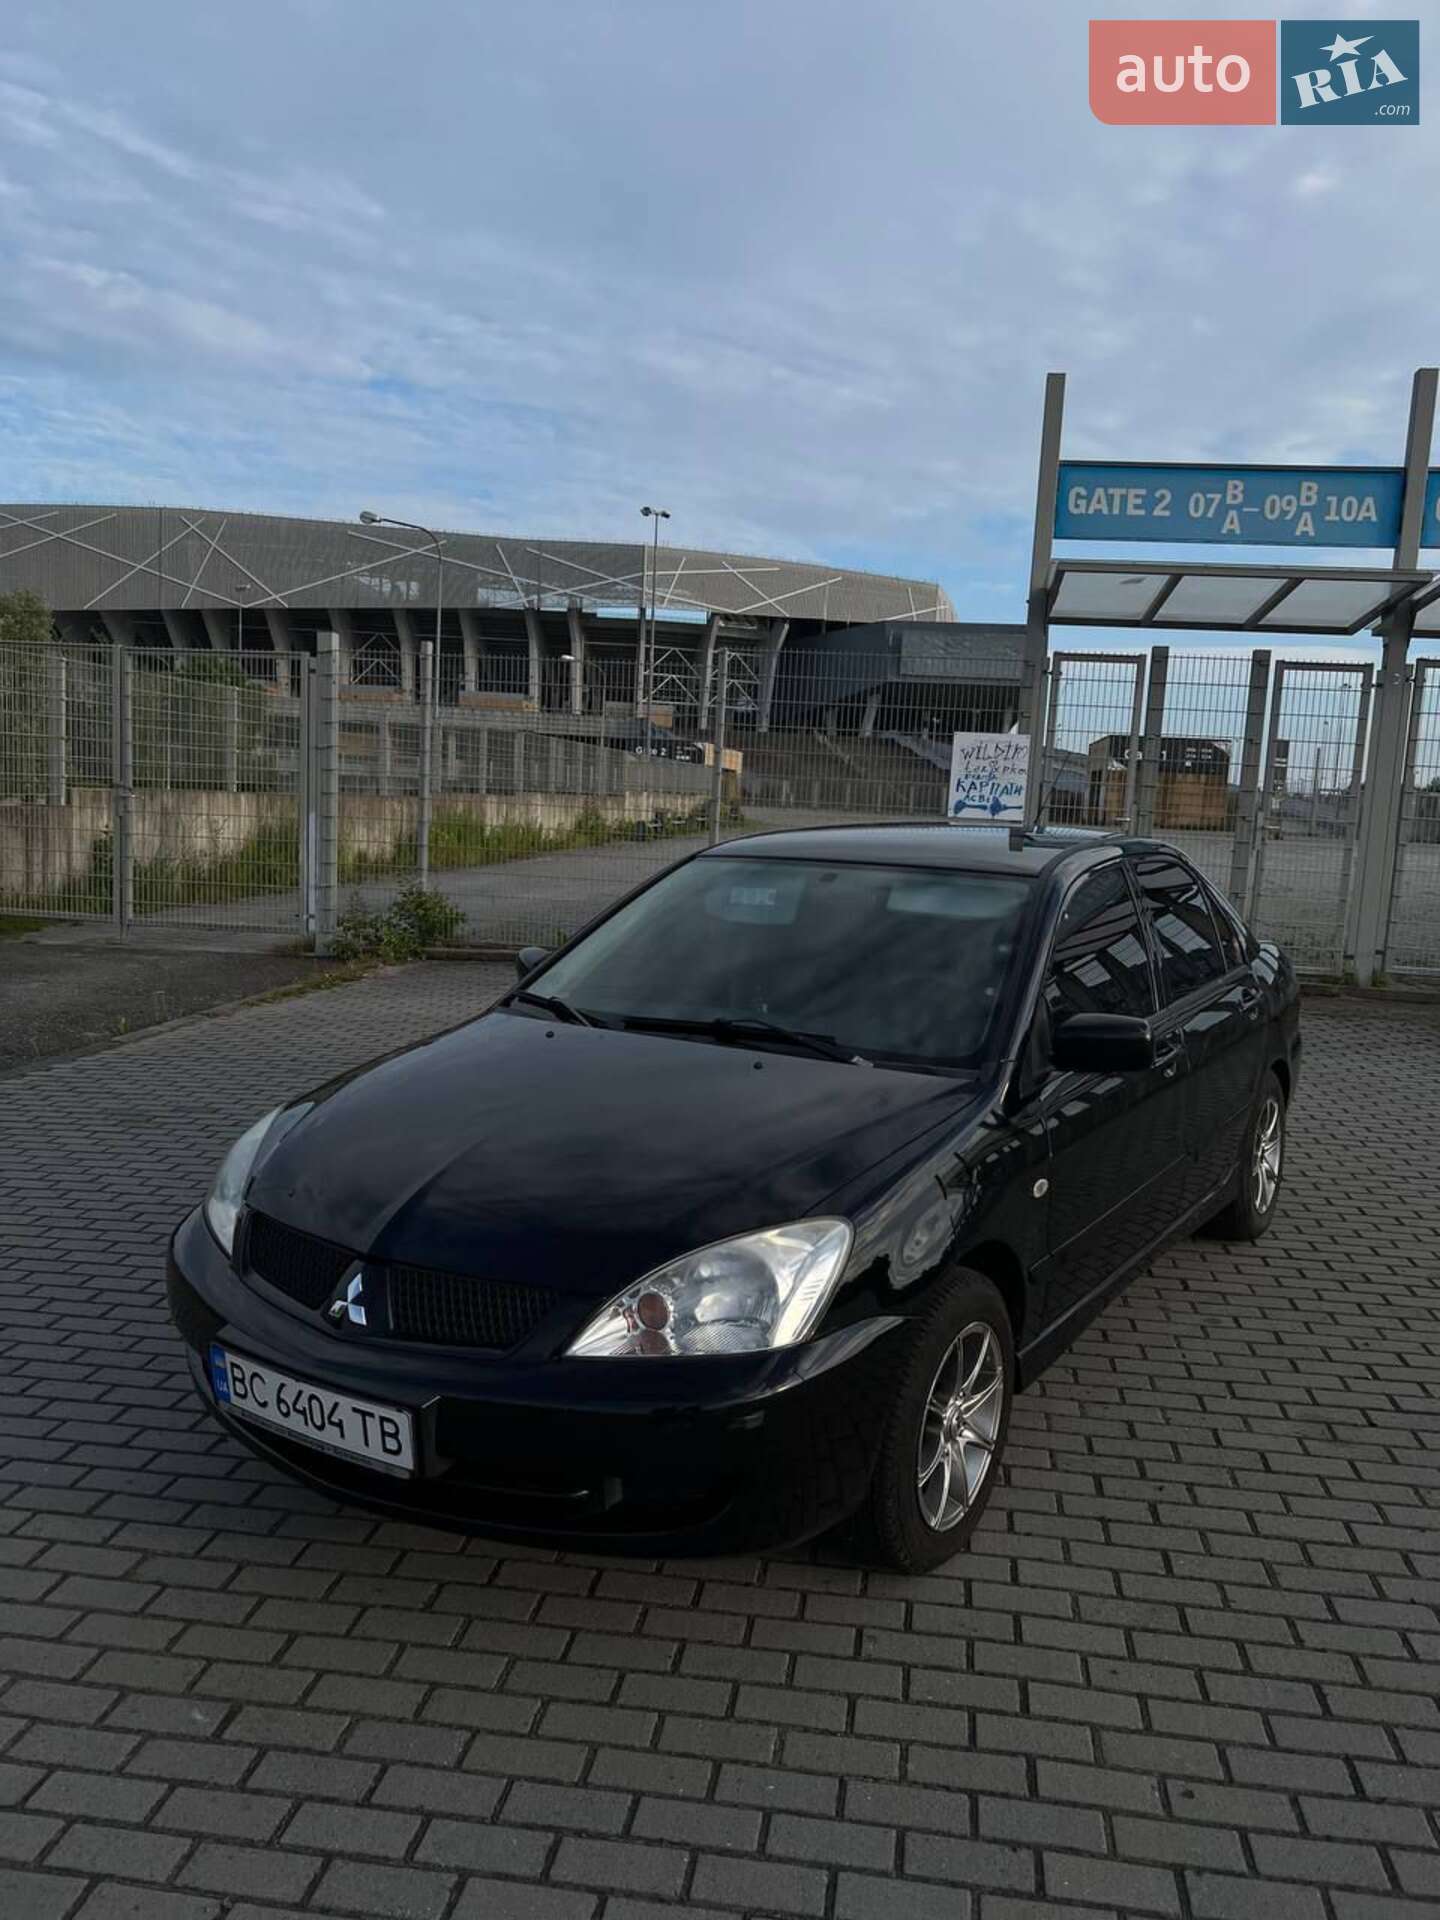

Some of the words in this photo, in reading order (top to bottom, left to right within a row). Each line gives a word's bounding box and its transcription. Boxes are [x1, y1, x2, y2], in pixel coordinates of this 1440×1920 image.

[1067, 486, 1147, 517] GATE
[1152, 488, 1171, 517] 2
[1324, 496, 1378, 523] 10A
[229, 1362, 269, 1409] BC
[275, 1382, 346, 1440] 6404
[351, 1406, 403, 1456] TB
